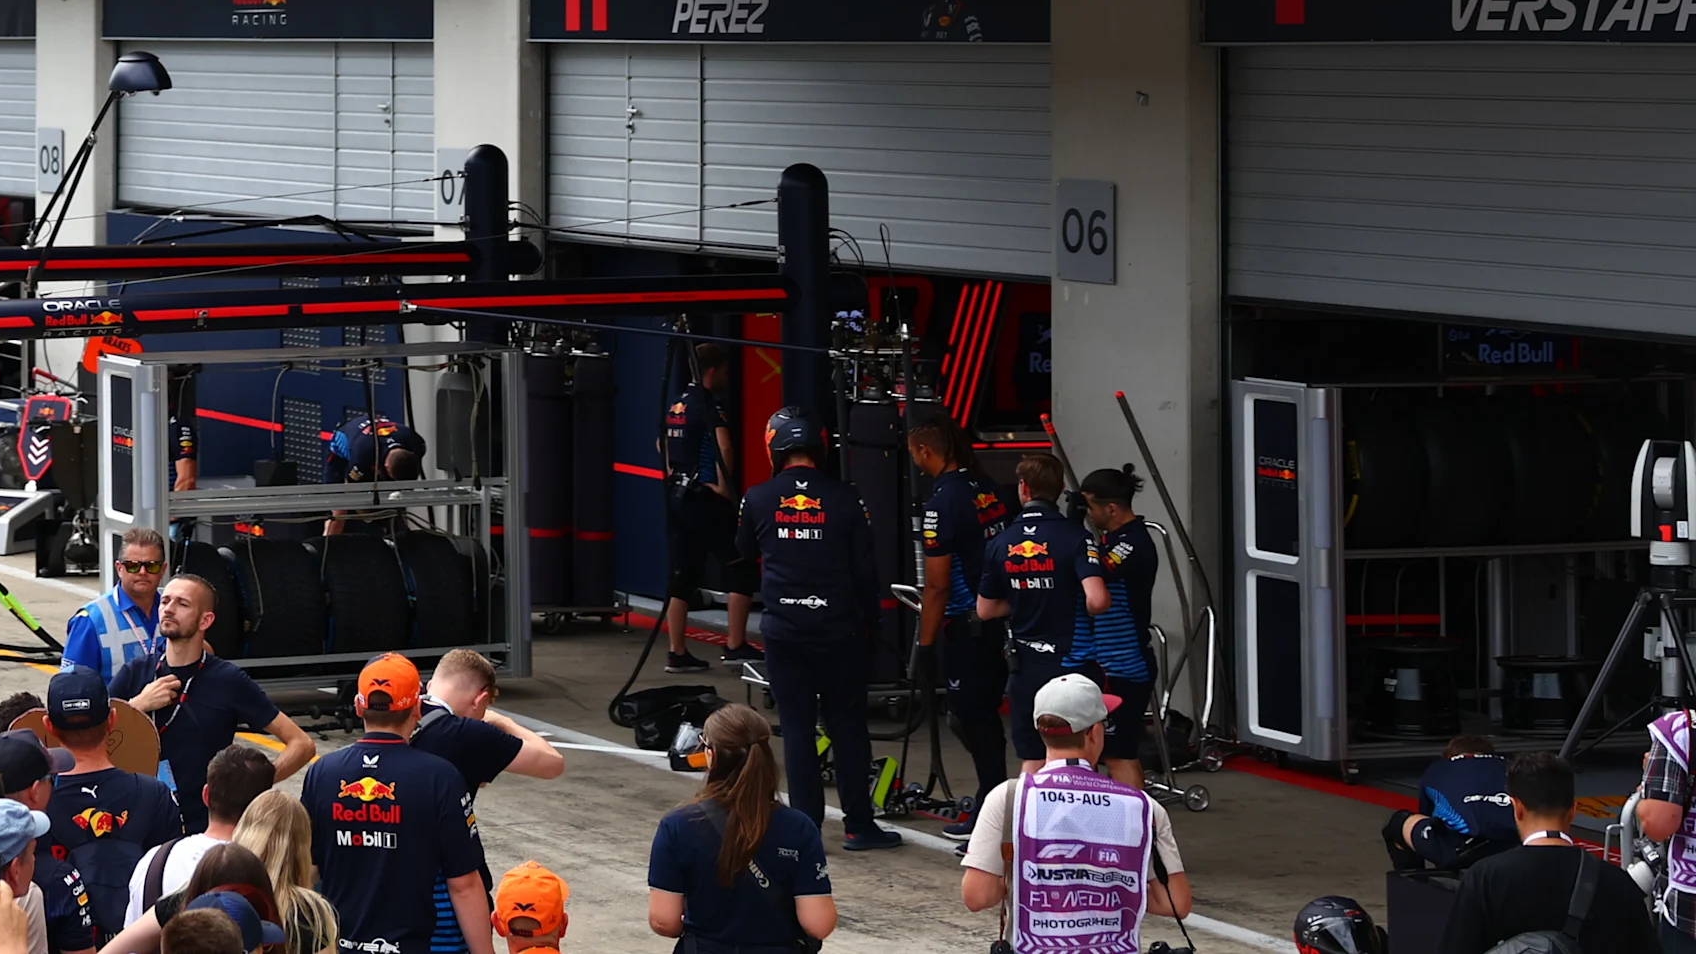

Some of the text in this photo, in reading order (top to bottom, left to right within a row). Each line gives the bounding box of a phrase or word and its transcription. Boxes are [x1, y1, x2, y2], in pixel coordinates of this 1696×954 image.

[232, 14, 287, 26] RACING
[40, 143, 61, 175] 08
[1061, 207, 1108, 256] 06
[42, 299, 121, 312] ORACLE
[42, 328, 122, 338] RACING
[1478, 341, 1554, 364] Red Bull
[1258, 456, 1296, 469] ORACLE
[775, 511, 826, 524] Red Bull
[778, 528, 810, 540] Mobil
[1005, 558, 1055, 574] Red Bull
[1010, 578, 1041, 590] Mobil
[1039, 791, 1111, 807] 1043-AUS
[332, 802, 401, 824] Red Bull
[336, 830, 382, 848] Mobil
[1062, 890, 1122, 908] MEDIA
